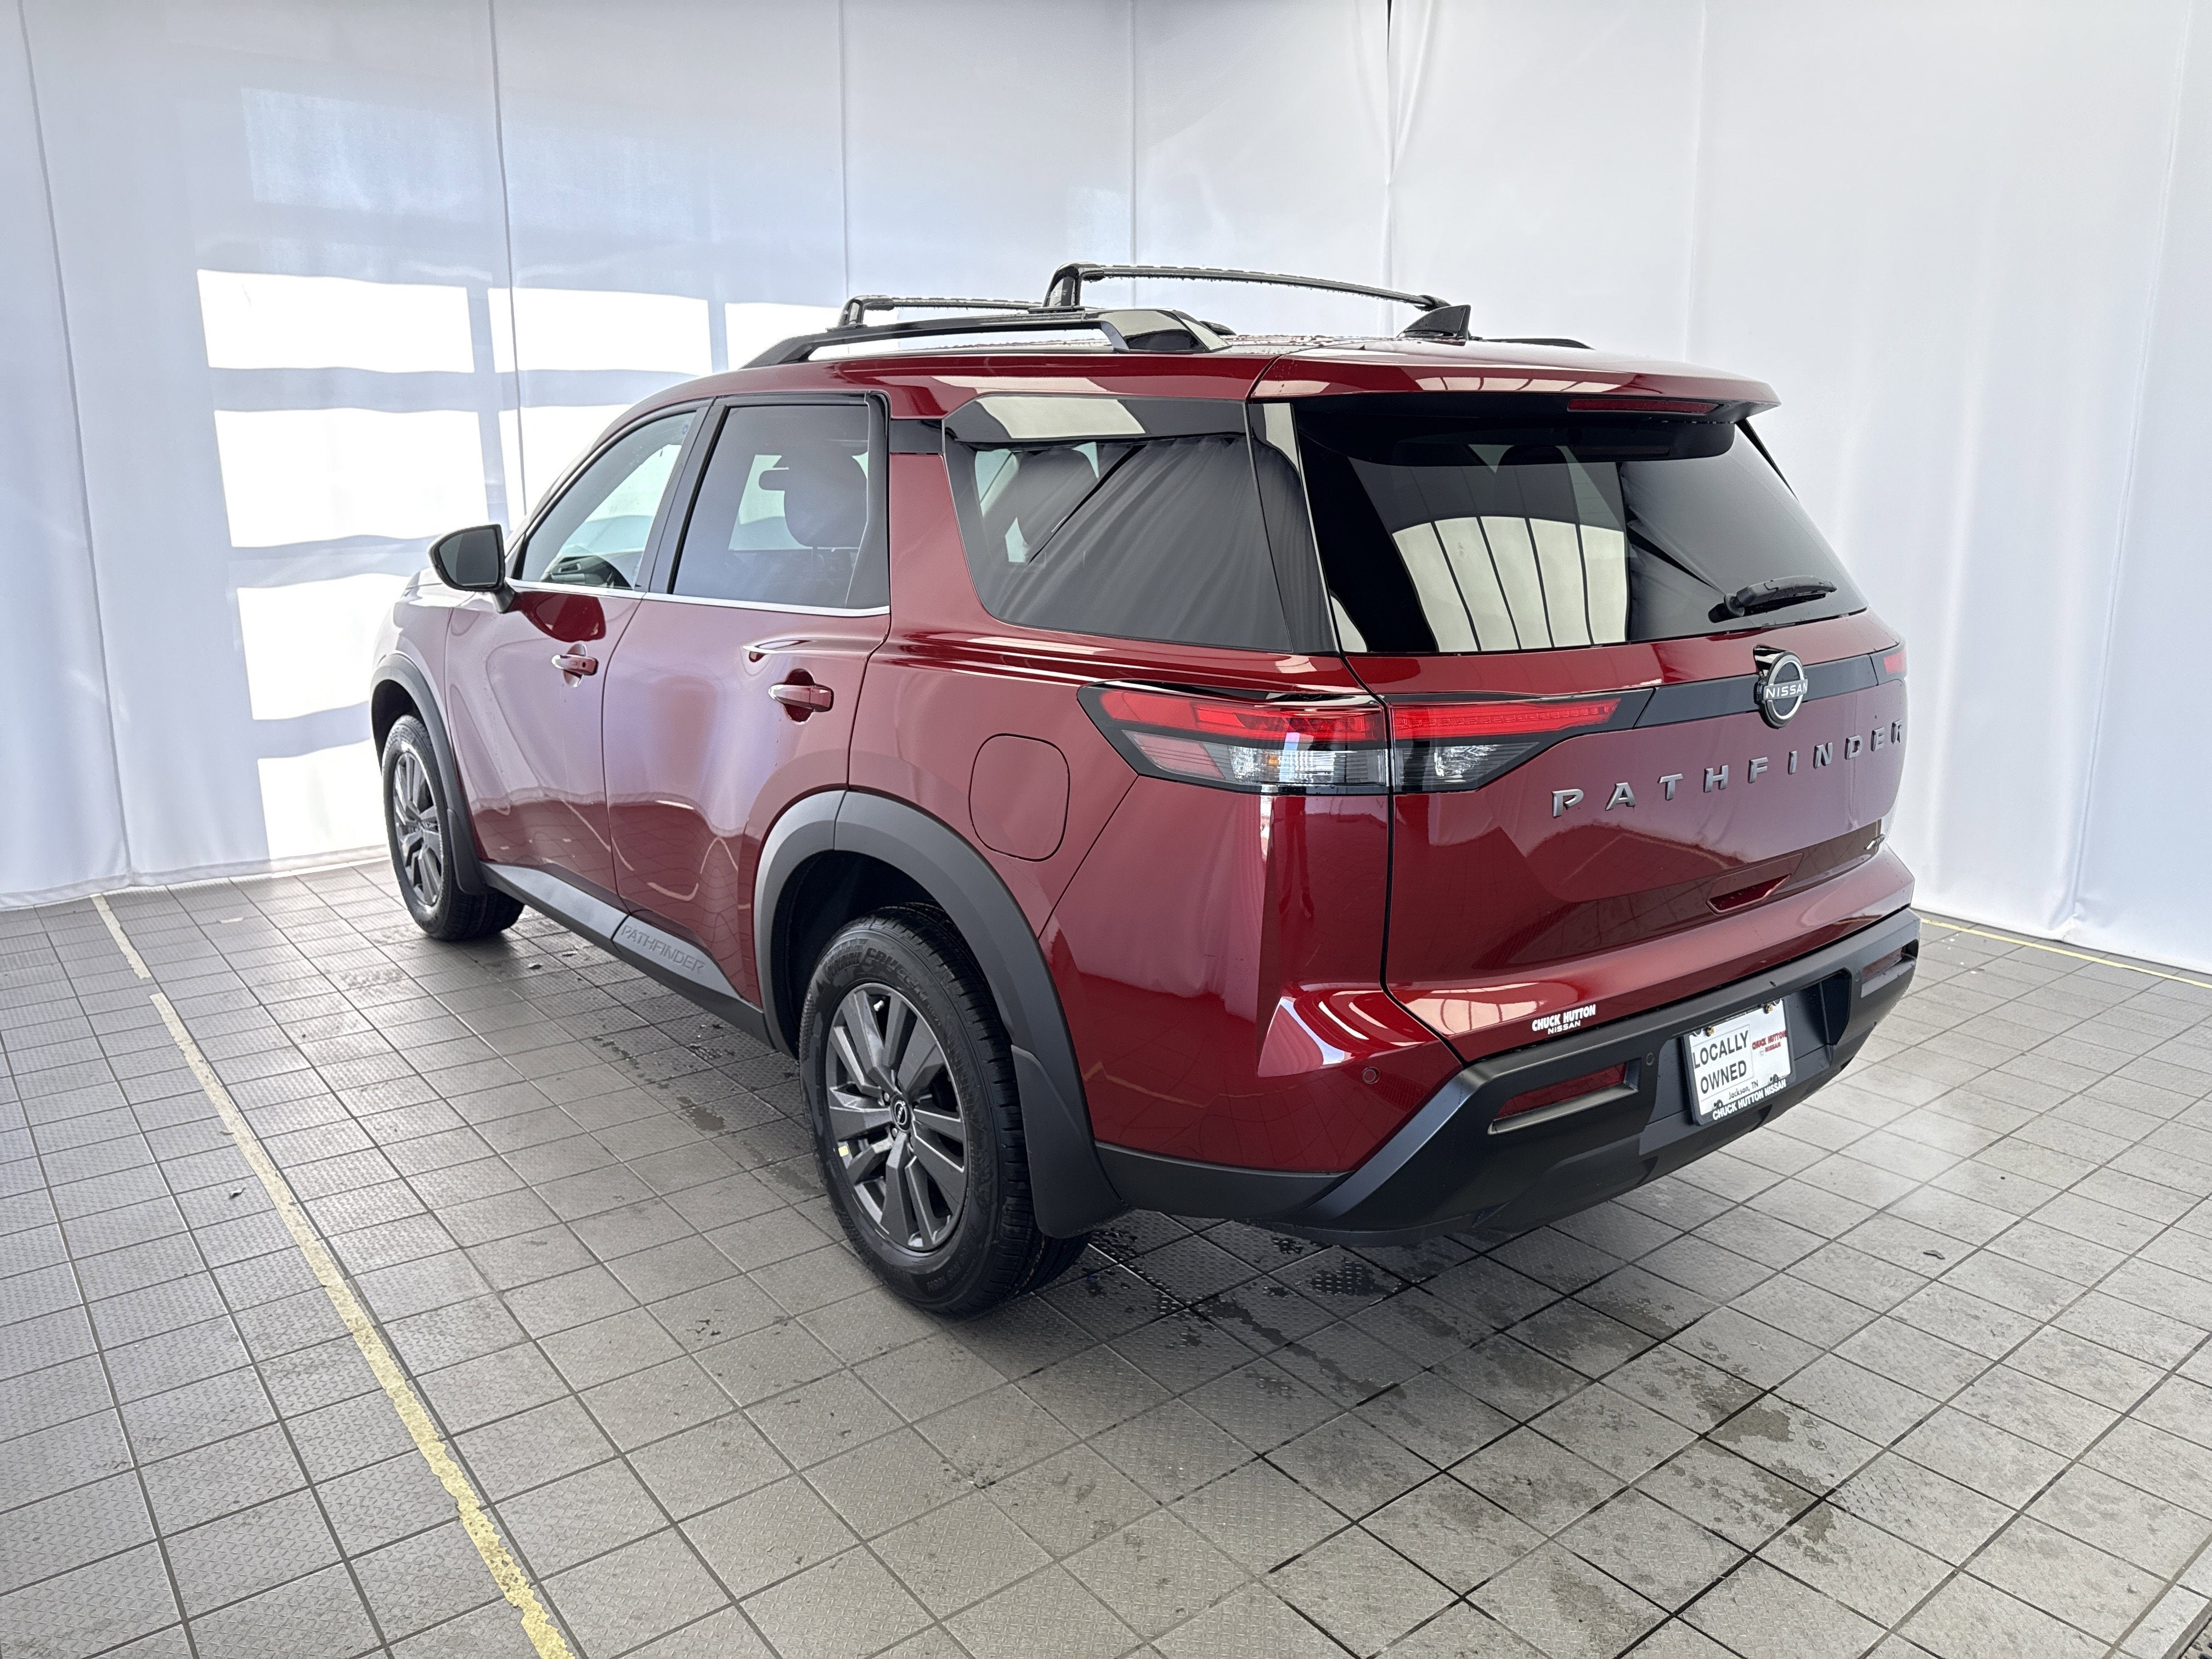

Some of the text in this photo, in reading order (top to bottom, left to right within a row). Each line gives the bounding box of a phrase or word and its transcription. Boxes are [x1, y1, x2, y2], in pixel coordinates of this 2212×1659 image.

[1765, 682, 1807, 698] NISSAN
[1552, 719, 1902, 818] PATHFINDER
[620, 924, 706, 975] PATHFINDER
[1532, 1004, 1596, 1031] CHUCK HUTTON
[1548, 1020, 1581, 1035] NISSAN
[1692, 1030, 1748, 1069] LOCALLY
[1752, 1037, 1767, 1050] CHUCK
[1765, 1042, 1781, 1052] NISSAN
[1700, 1060, 1747, 1094] OWNED
[1728, 1079, 1759, 1100] Jackson, TN
[1712, 1078, 1786, 1120] CHUCK HUTTON NISSAN
